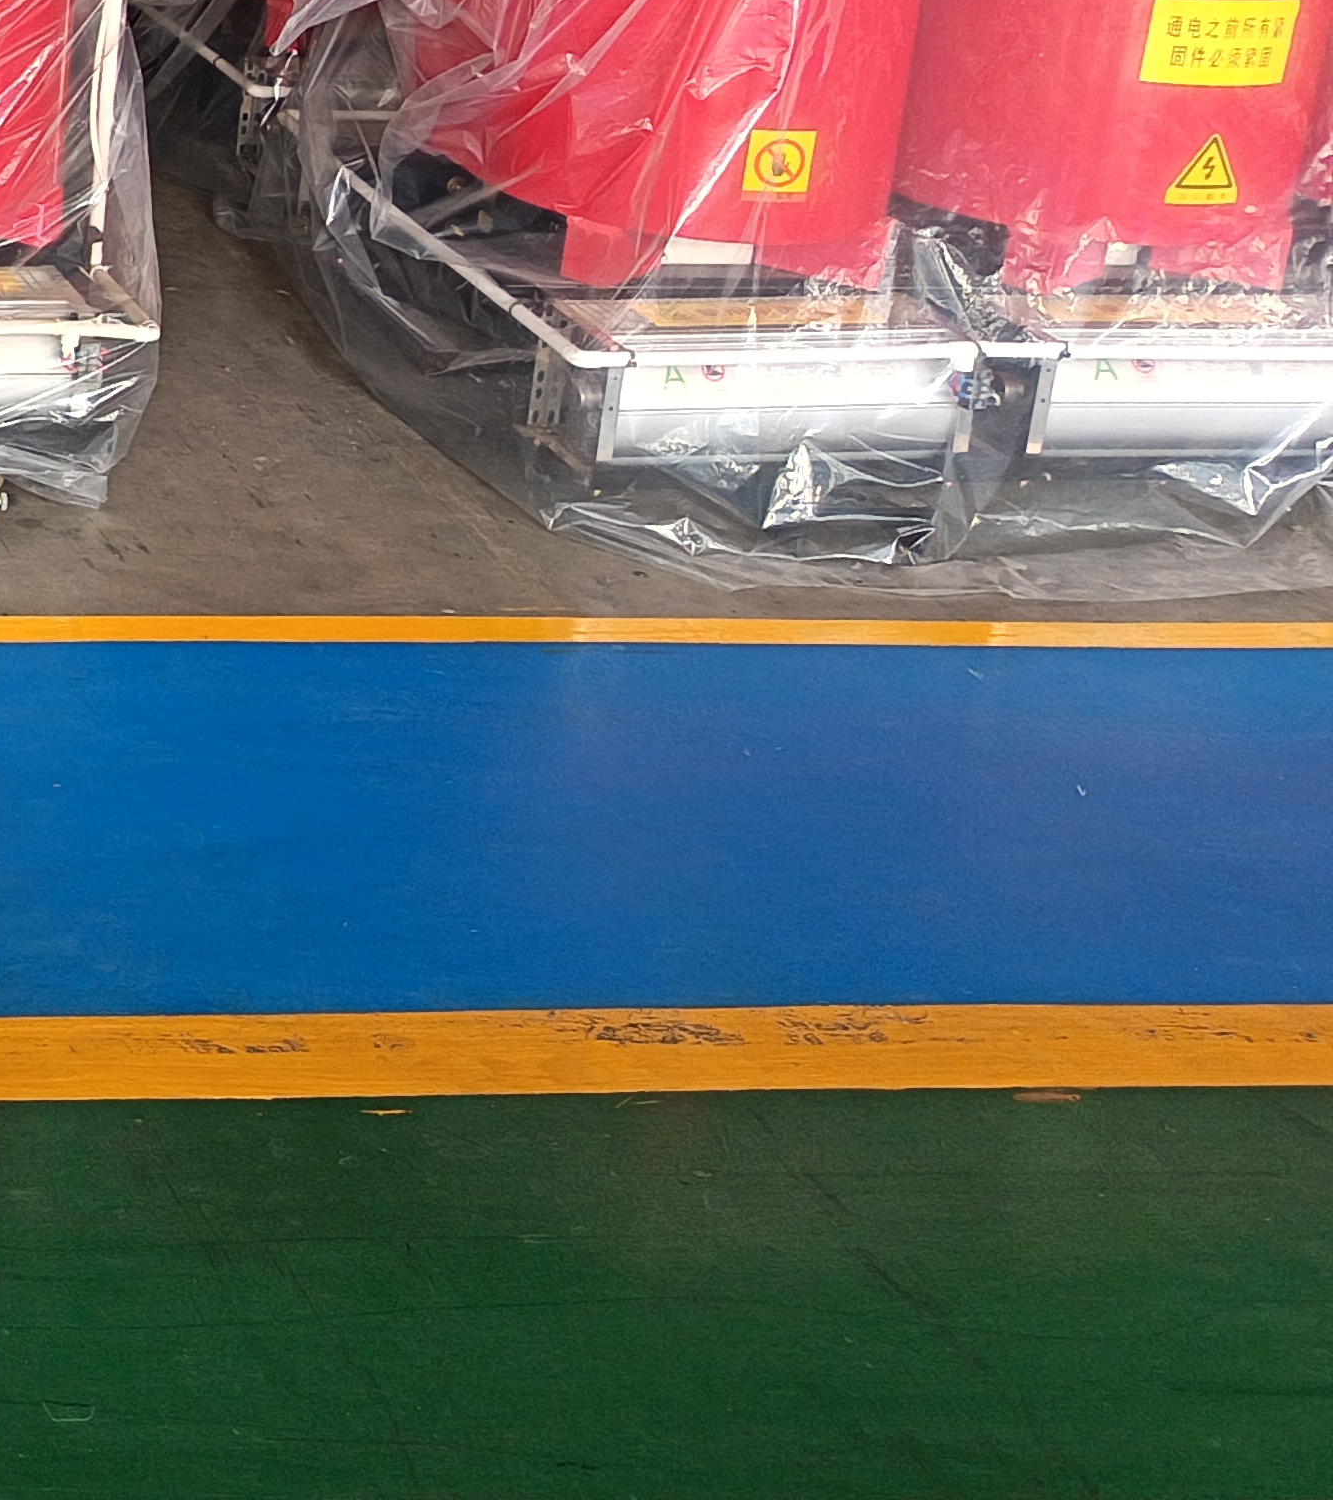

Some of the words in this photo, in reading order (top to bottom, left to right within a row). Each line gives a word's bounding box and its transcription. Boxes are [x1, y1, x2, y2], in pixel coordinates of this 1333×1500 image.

[1165, 15, 1286, 40] 通电之前所有紧
[1169, 44, 1274, 68] 固件必须紧固
